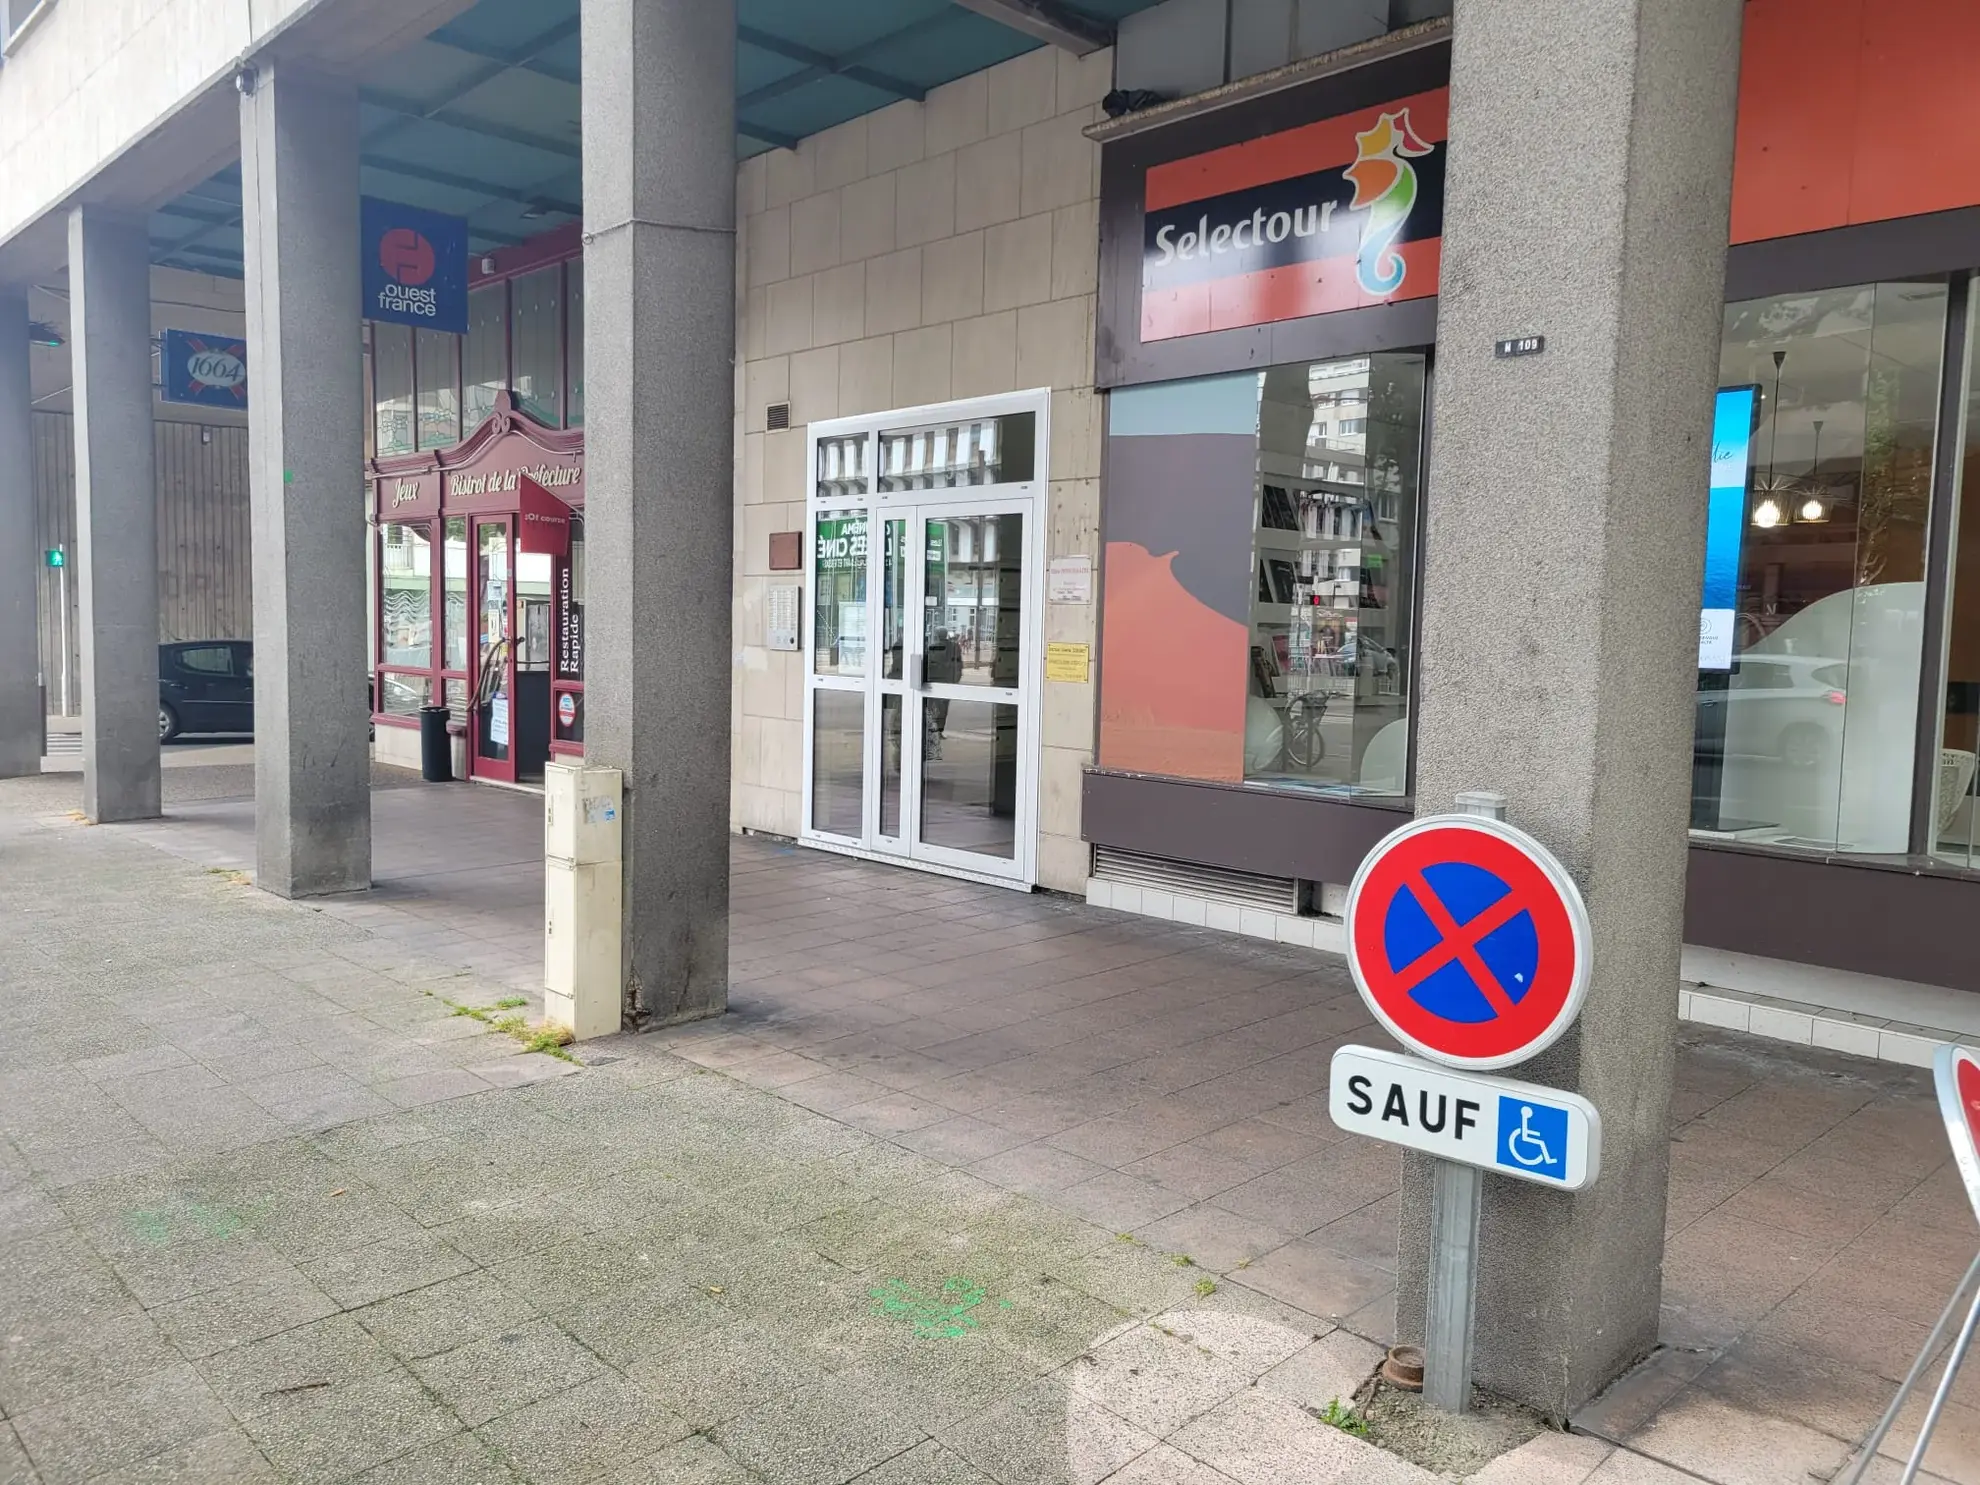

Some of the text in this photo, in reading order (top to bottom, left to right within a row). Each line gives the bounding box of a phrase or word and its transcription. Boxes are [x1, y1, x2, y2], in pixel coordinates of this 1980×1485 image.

[1155, 200, 1337, 266] Selectour
[378, 292, 436, 316] france
[385, 284, 436, 304] ouest
[1517, 339, 1538, 351] 109
[192, 355, 243, 381] 1664
[392, 478, 419, 508] Jeux
[451, 464, 581, 496] Bistrot de la Péfecture
[559, 567, 569, 672] Restauration
[570, 613, 581, 673] Rapide
[1347, 1075, 1480, 1140] SAUF
